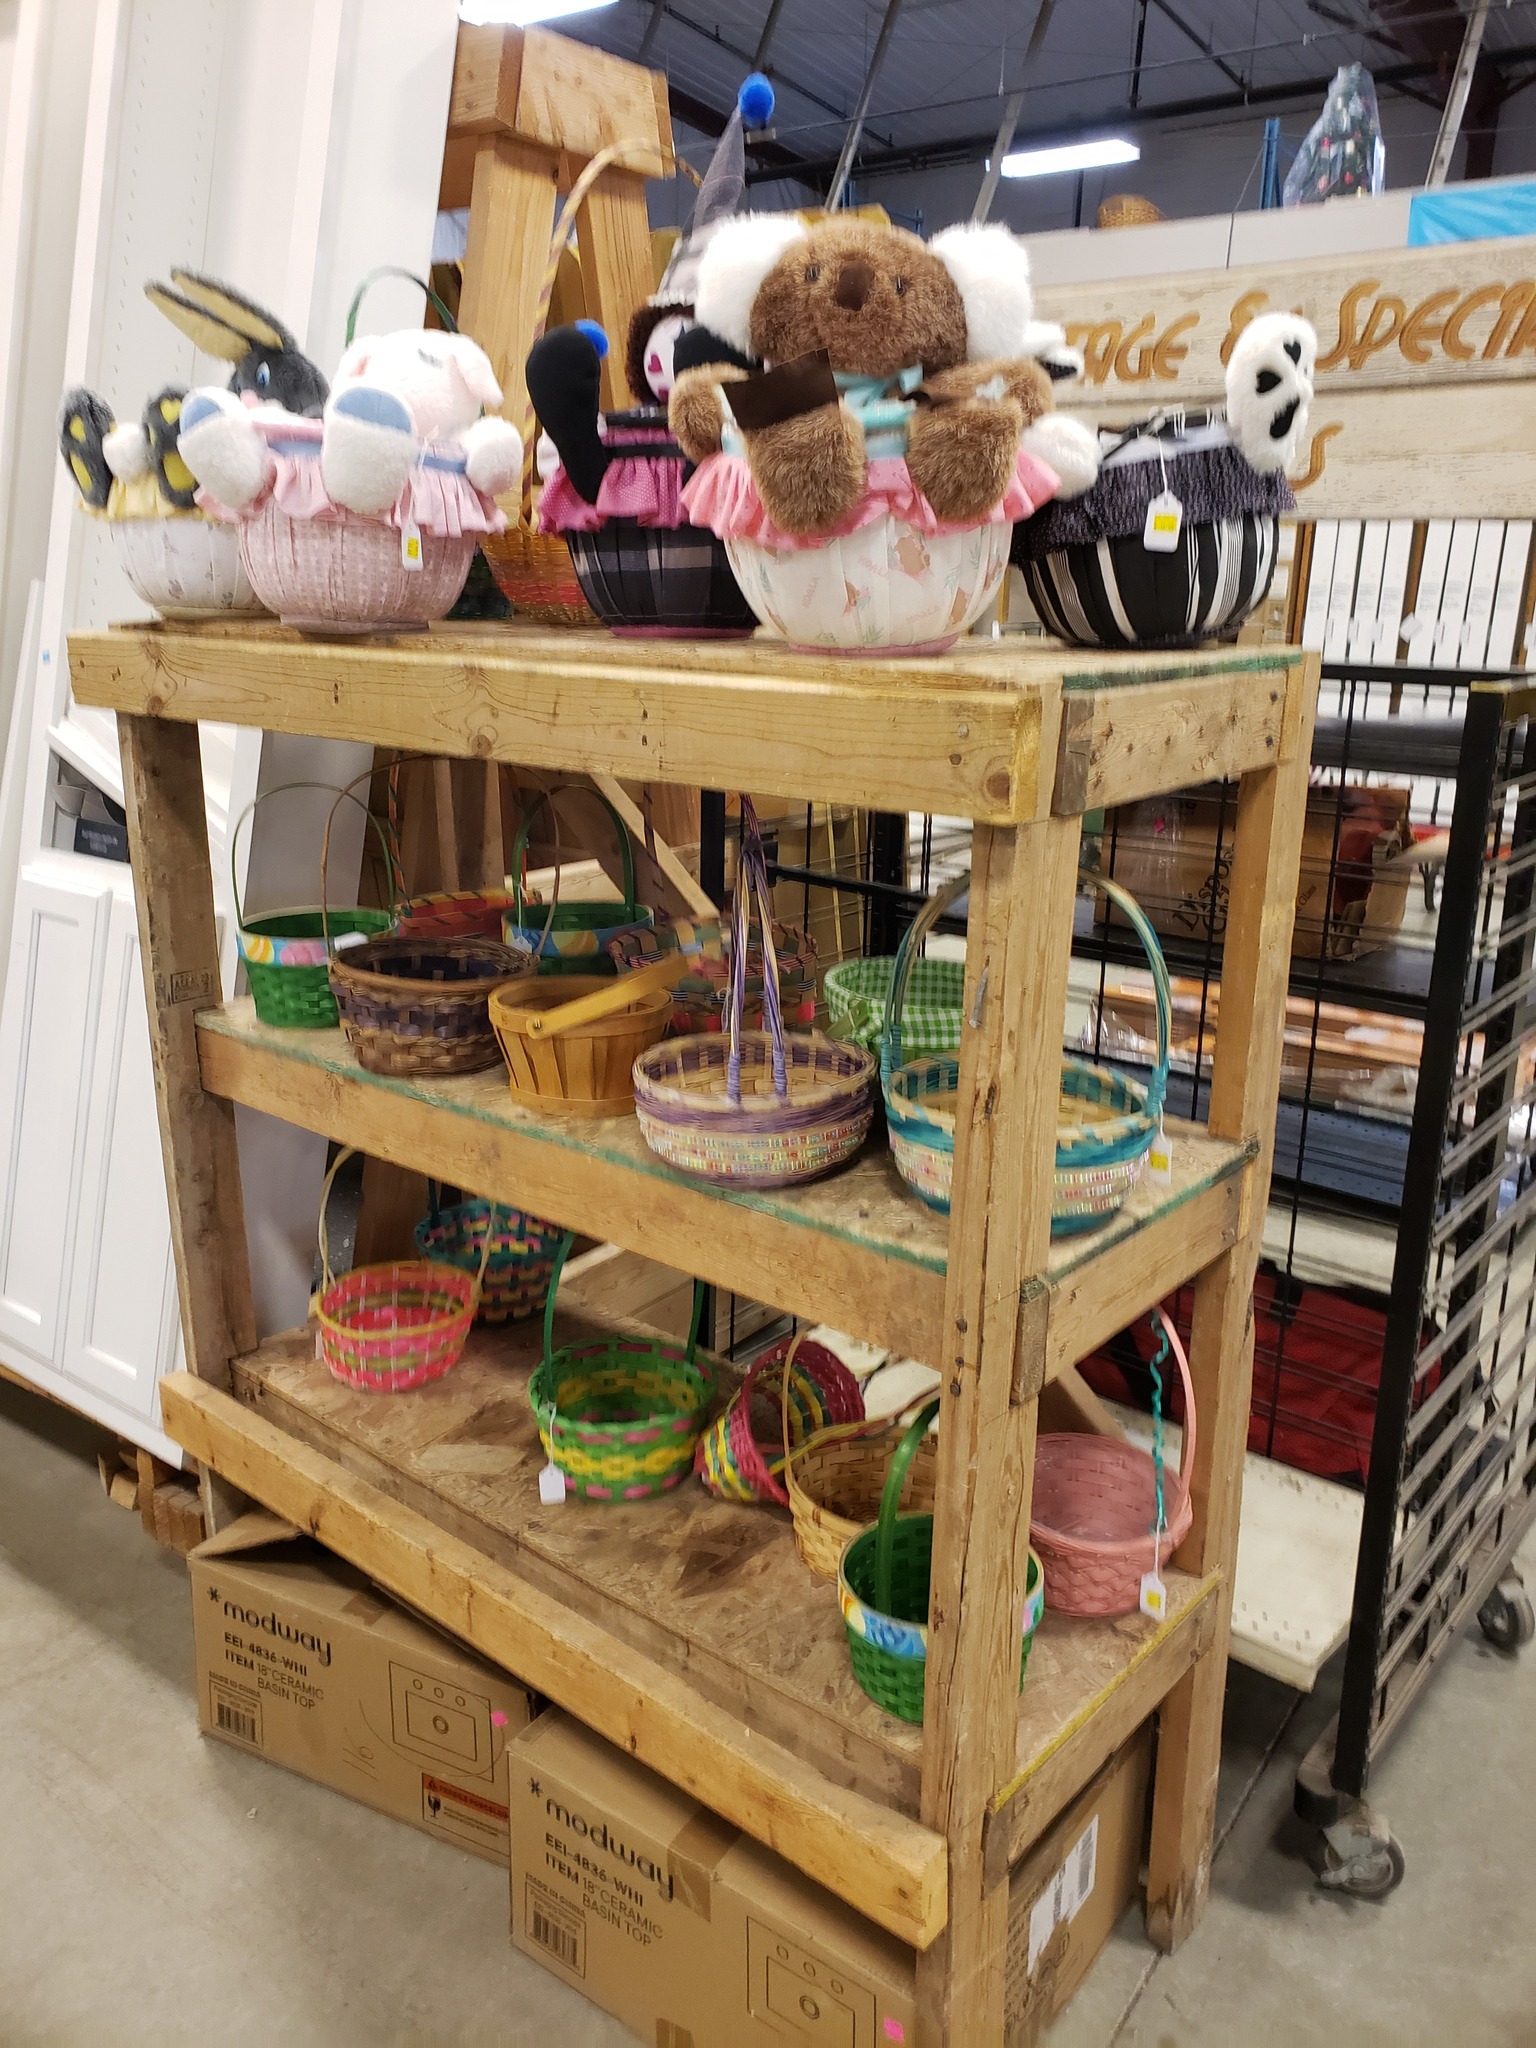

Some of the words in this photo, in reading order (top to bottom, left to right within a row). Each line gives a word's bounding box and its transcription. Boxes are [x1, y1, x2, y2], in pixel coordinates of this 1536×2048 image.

[223, 1601, 332, 1668] modway
[224, 1632, 307, 1677] EEI-4836-WHI
[225, 1649, 254, 1671] ITEM
[257, 1677, 290, 1700] BASIN
[292, 1691, 316, 1710] TOP
[545, 1852, 579, 1884] ITEM
[545, 1832, 643, 1907] EEI-4836-WHI
[546, 1798, 674, 1903] modway
[582, 1893, 621, 1929] BASIN
[625, 1920, 652, 1946] TOP
